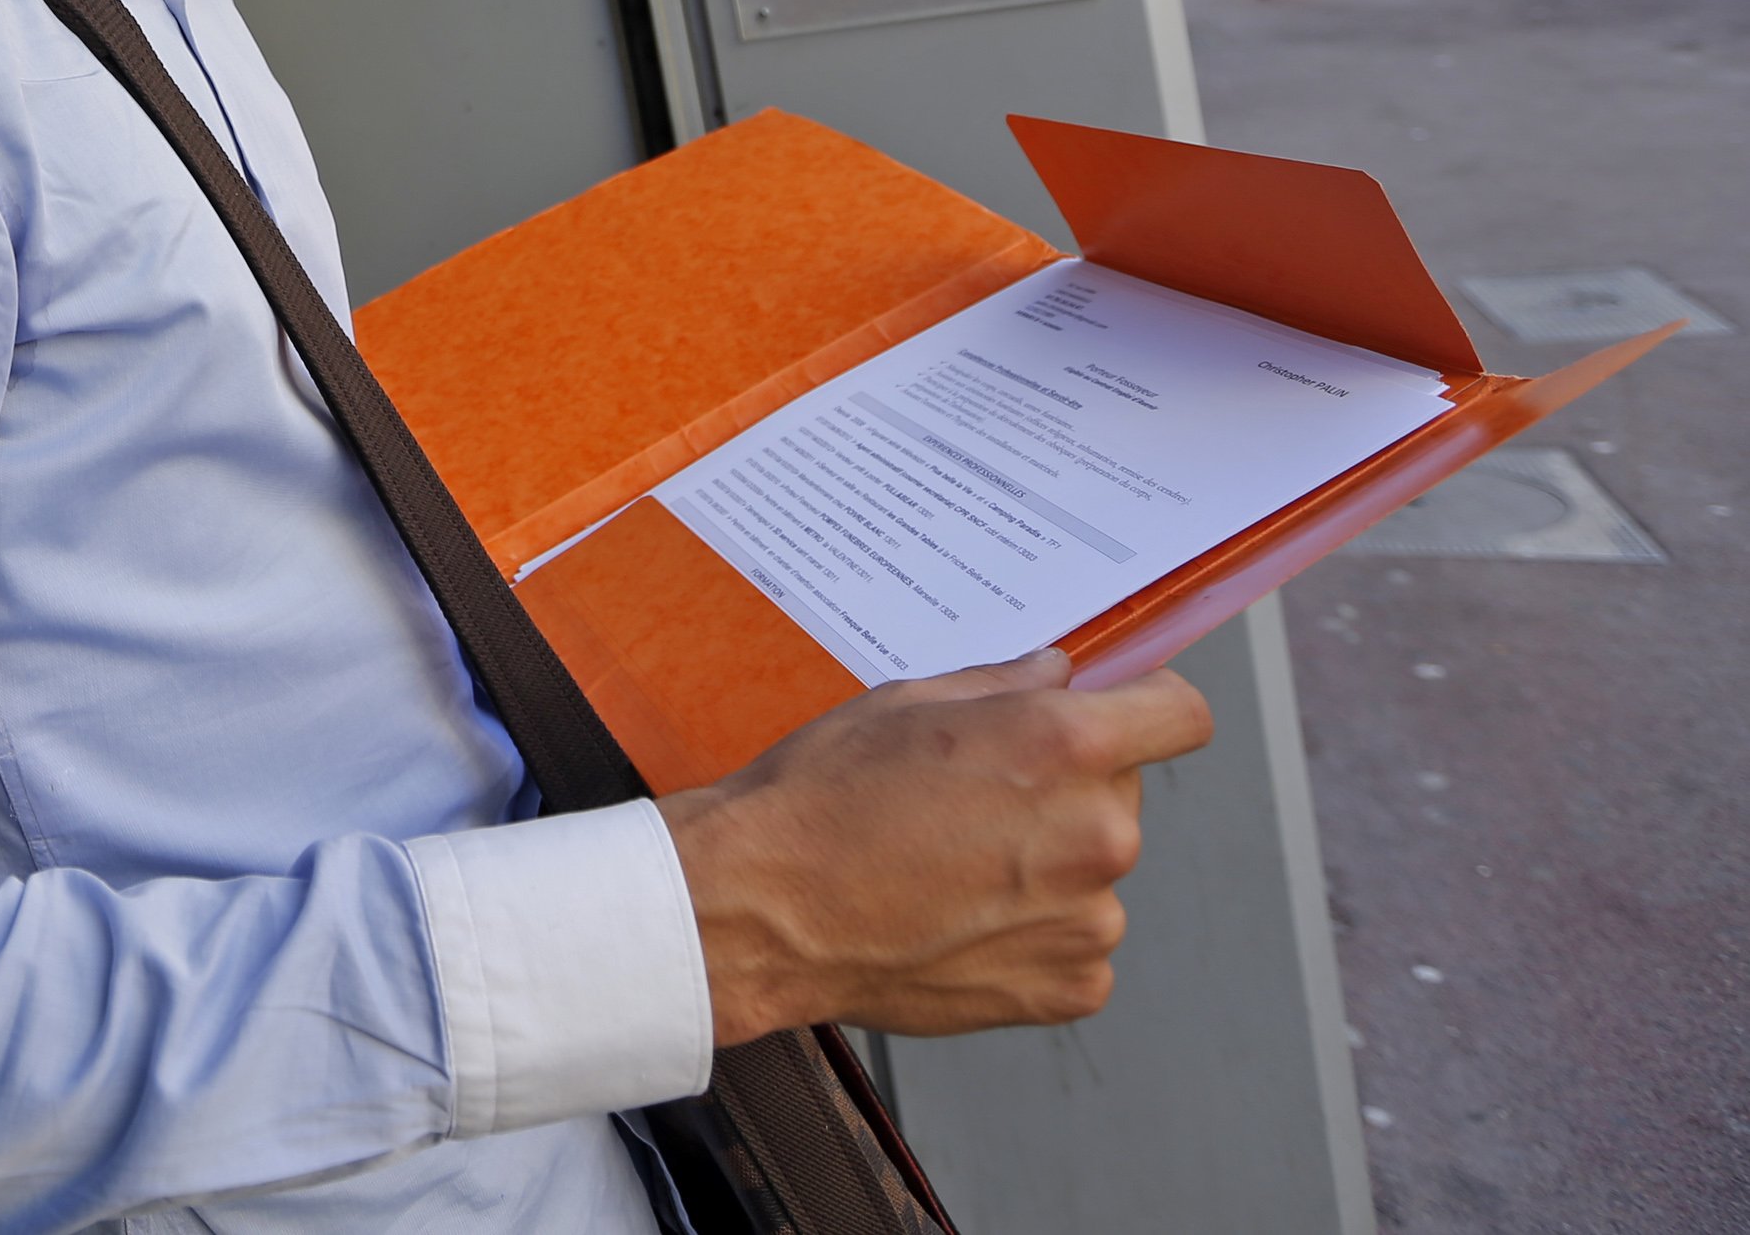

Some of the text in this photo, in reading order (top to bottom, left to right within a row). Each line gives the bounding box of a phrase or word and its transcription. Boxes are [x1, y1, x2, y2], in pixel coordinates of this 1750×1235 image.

[1085, 363, 1159, 399] Porteur Fossoyeur
[1255, 360, 1349, 398] Christopher PALIN
[922, 435, 1027, 498] EXPERIENCES PROFESSIONNELLES
[843, 506, 866, 522] POIVRE
[862, 521, 885, 536] BLANC
[928, 465, 944, 475] Plus
[941, 473, 958, 483] belle
[960, 485, 974, 494] Vie
[986, 502, 1018, 522] Camping
[1015, 519, 1043, 537] Paradis
[1045, 539, 1062, 549] TF1
[953, 505, 970, 516] CPR
[966, 514, 988, 528] SNCF
[778, 533, 798, 547] service
[803, 526, 825, 542] METRO
[894, 517, 921, 535] Grandes
[917, 533, 940, 549] Tables
[947, 555, 969, 569] Friche
[965, 568, 985, 580] Belle
[981, 578, 993, 587] de
[818, 513, 842, 530] POMPES
[839, 529, 872, 553] FUNEBRES
[911, 585, 941, 606] Marseille
[750, 568, 785, 597] FORMATION
[838, 611, 864, 632] Fresque
[860, 630, 878, 644] Belle
[875, 643, 891, 654] Vue
